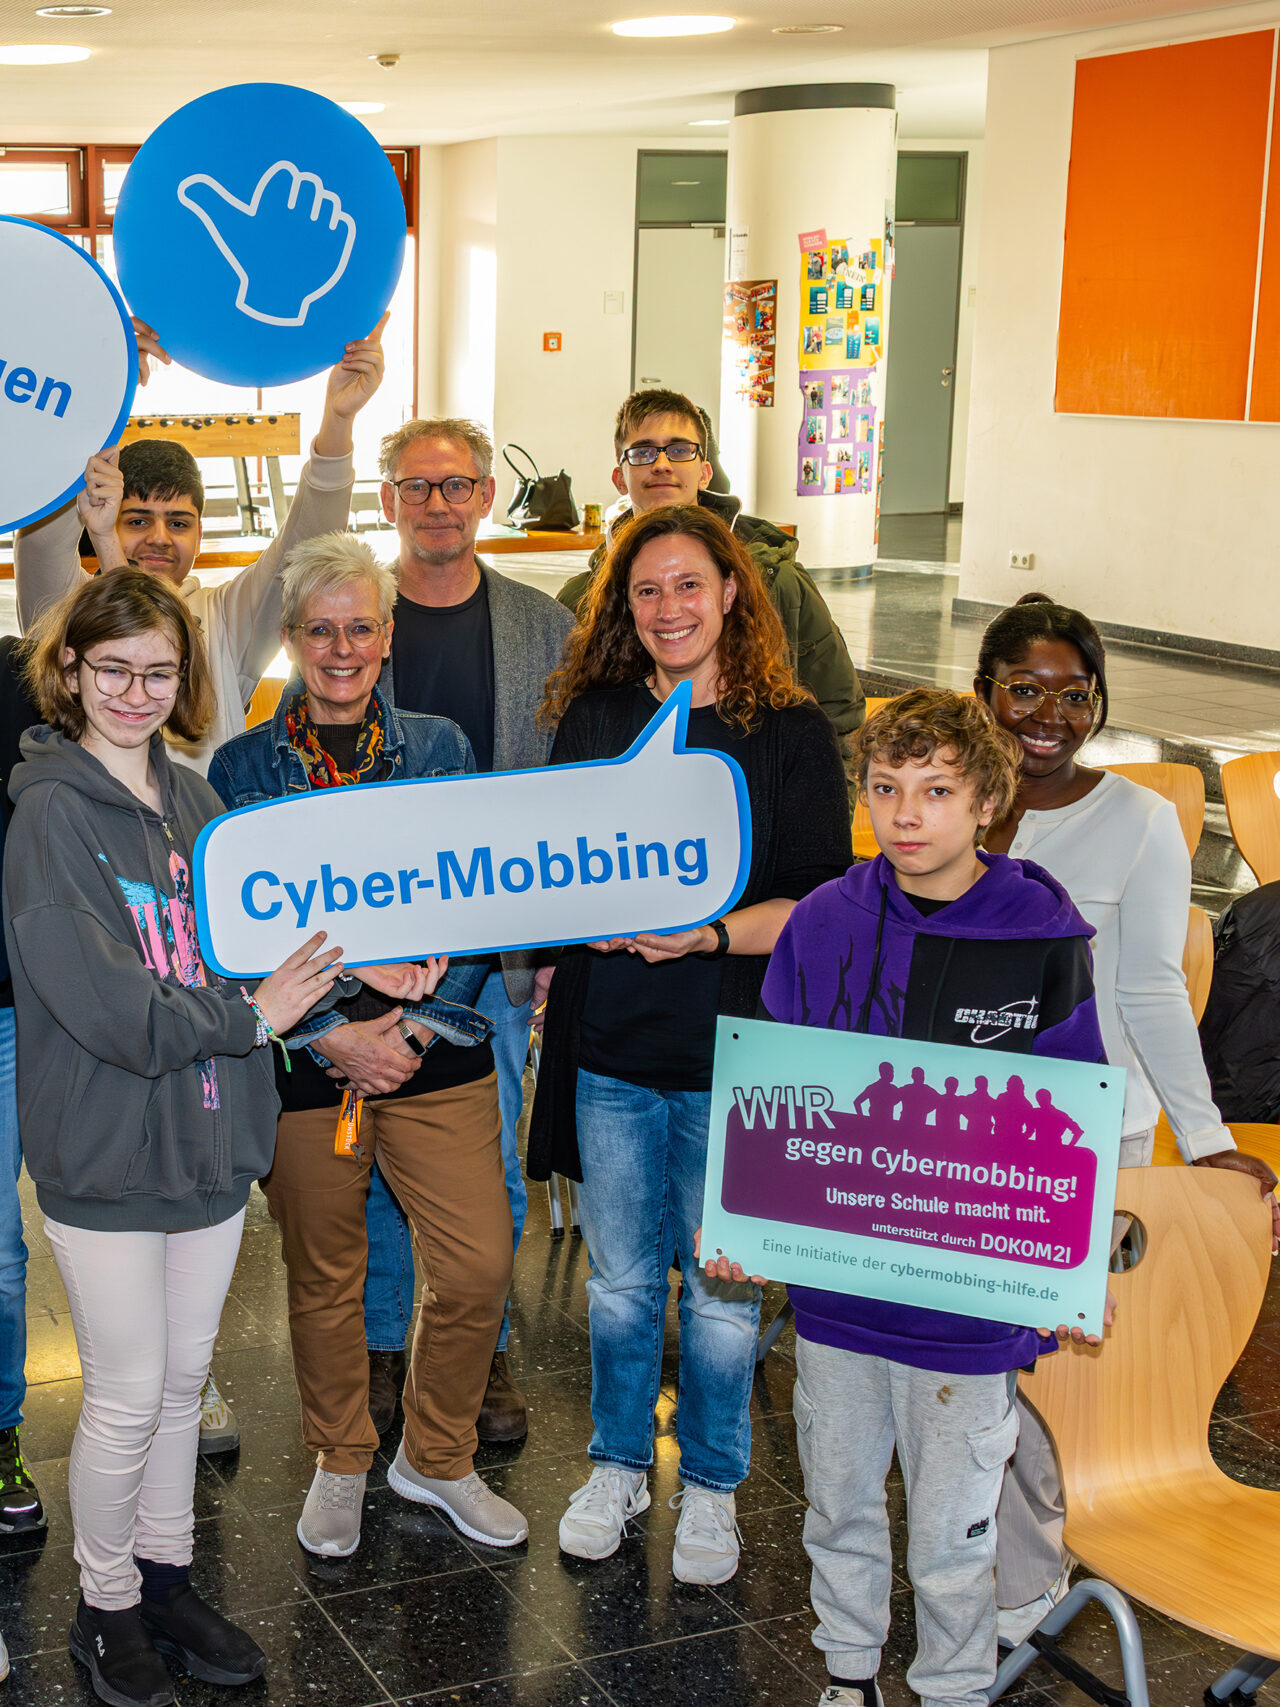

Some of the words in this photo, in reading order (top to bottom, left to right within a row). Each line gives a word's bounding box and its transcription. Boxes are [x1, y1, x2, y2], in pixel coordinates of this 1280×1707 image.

[239, 831, 710, 929] Cyber-Mobbing
[732, 1085, 836, 1130] WIR
[785, 1137, 862, 1165] gegen
[871, 1146, 1078, 1202] Cybermobbing!
[826, 1187, 885, 1208] Unsere
[891, 1193, 949, 1214] Schule
[954, 1200, 1010, 1220] macht
[1016, 1203, 1050, 1223] mit.
[871, 1222, 939, 1243] unterstützt
[941, 1232, 976, 1248] durch
[762, 1238, 791, 1255] Eine
[796, 1244, 858, 1266] Initiative
[862, 1254, 887, 1271] der
[890, 1263, 1059, 1302] cybermobbing-hilfe.de
